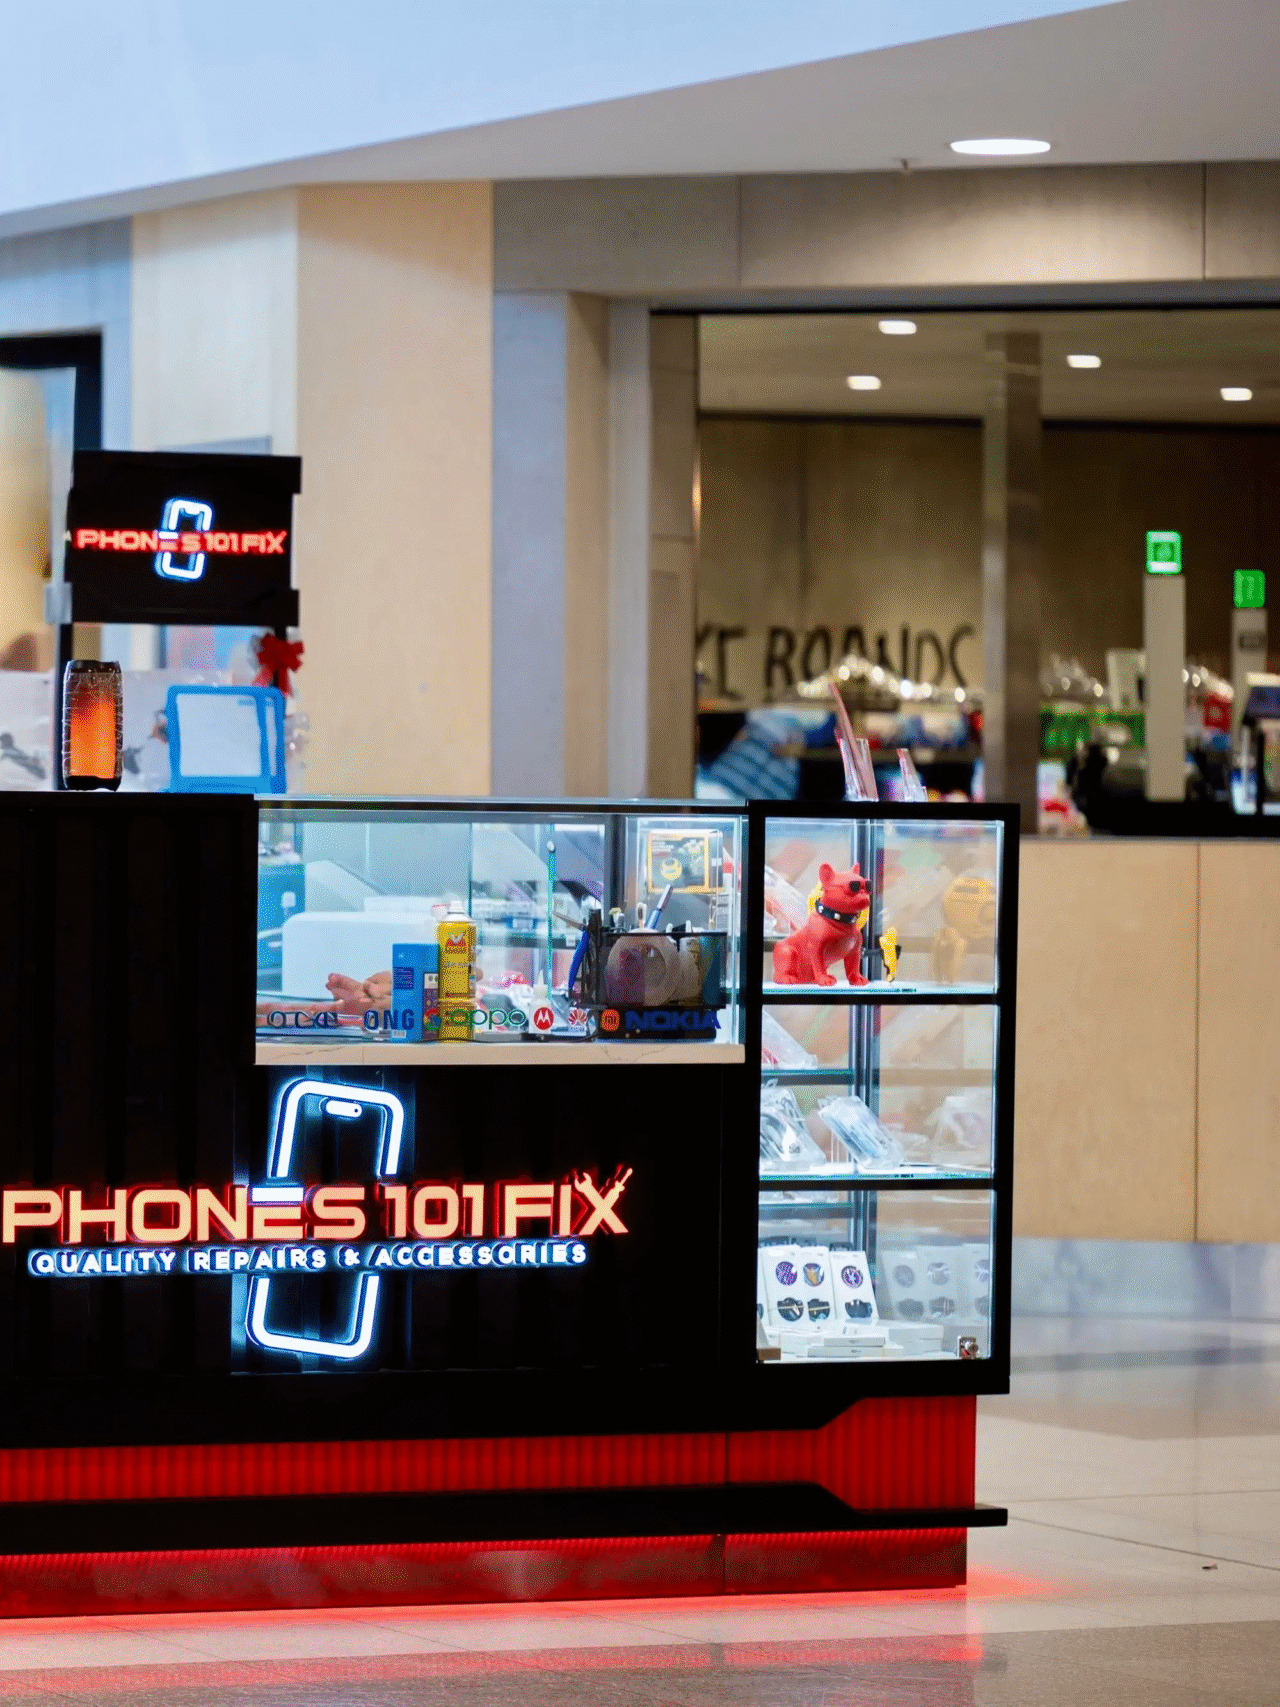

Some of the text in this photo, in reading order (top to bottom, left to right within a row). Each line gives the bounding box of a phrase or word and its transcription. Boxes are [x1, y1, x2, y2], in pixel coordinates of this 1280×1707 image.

[75, 529, 287, 554] PHONES 101 FIX
[450, 1008, 527, 1030] oppo
[624, 1009, 722, 1030] NOKIA
[383, 1182, 486, 1239] 101
[502, 1167, 634, 1238] FIX
[31, 1243, 587, 1275] QUALITY REPAIRS & ACCESSORIES
